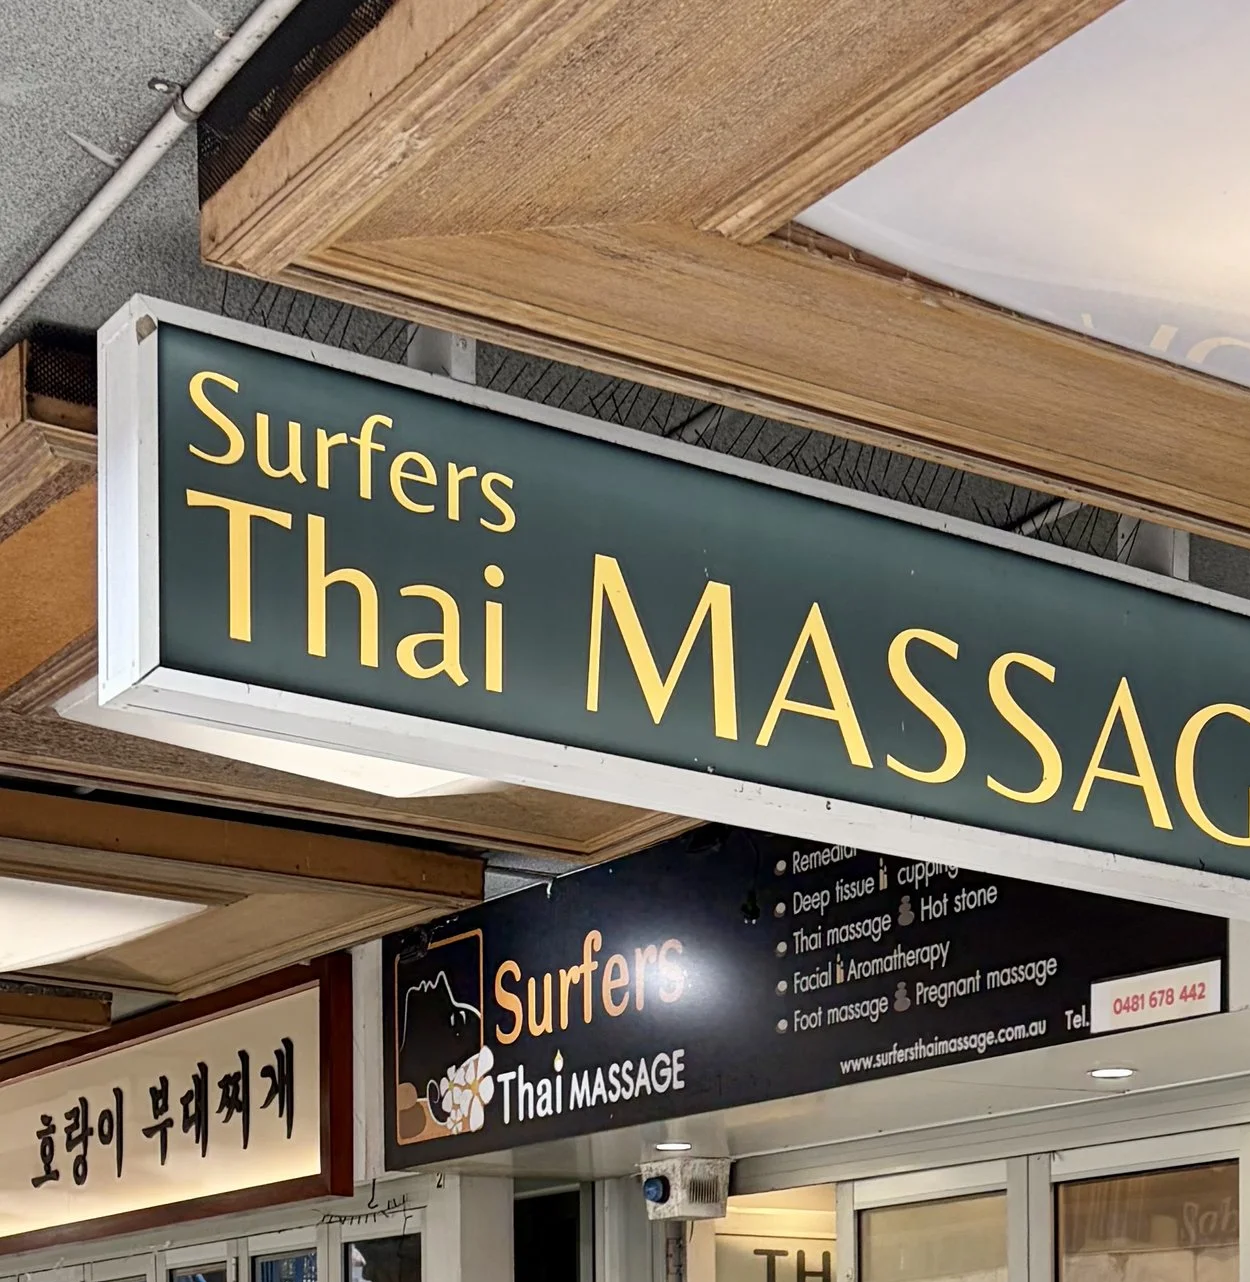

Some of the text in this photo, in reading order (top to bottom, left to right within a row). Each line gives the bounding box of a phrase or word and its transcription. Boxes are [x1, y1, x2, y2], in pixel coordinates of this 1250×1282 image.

[188, 371, 517, 533] Surfers
[186, 488, 506, 693] Thai
[793, 859, 958, 916] Deep tissue cupping
[793, 886, 998, 954] Thai massage Hot stone
[495, 929, 686, 1045] Surfers
[793, 939, 951, 994] Facial Aromatherapy
[793, 955, 1058, 1032] Foot massage Pregnant massage
[1113, 981, 1206, 1015] 0481 678 442
[840, 1006, 1090, 1075] www.surfersthaimassage.com.au Tel.
[31, 1036, 294, 1188] 호랑이 부대찌개
[497, 1048, 685, 1125] Thai MASSAGE
